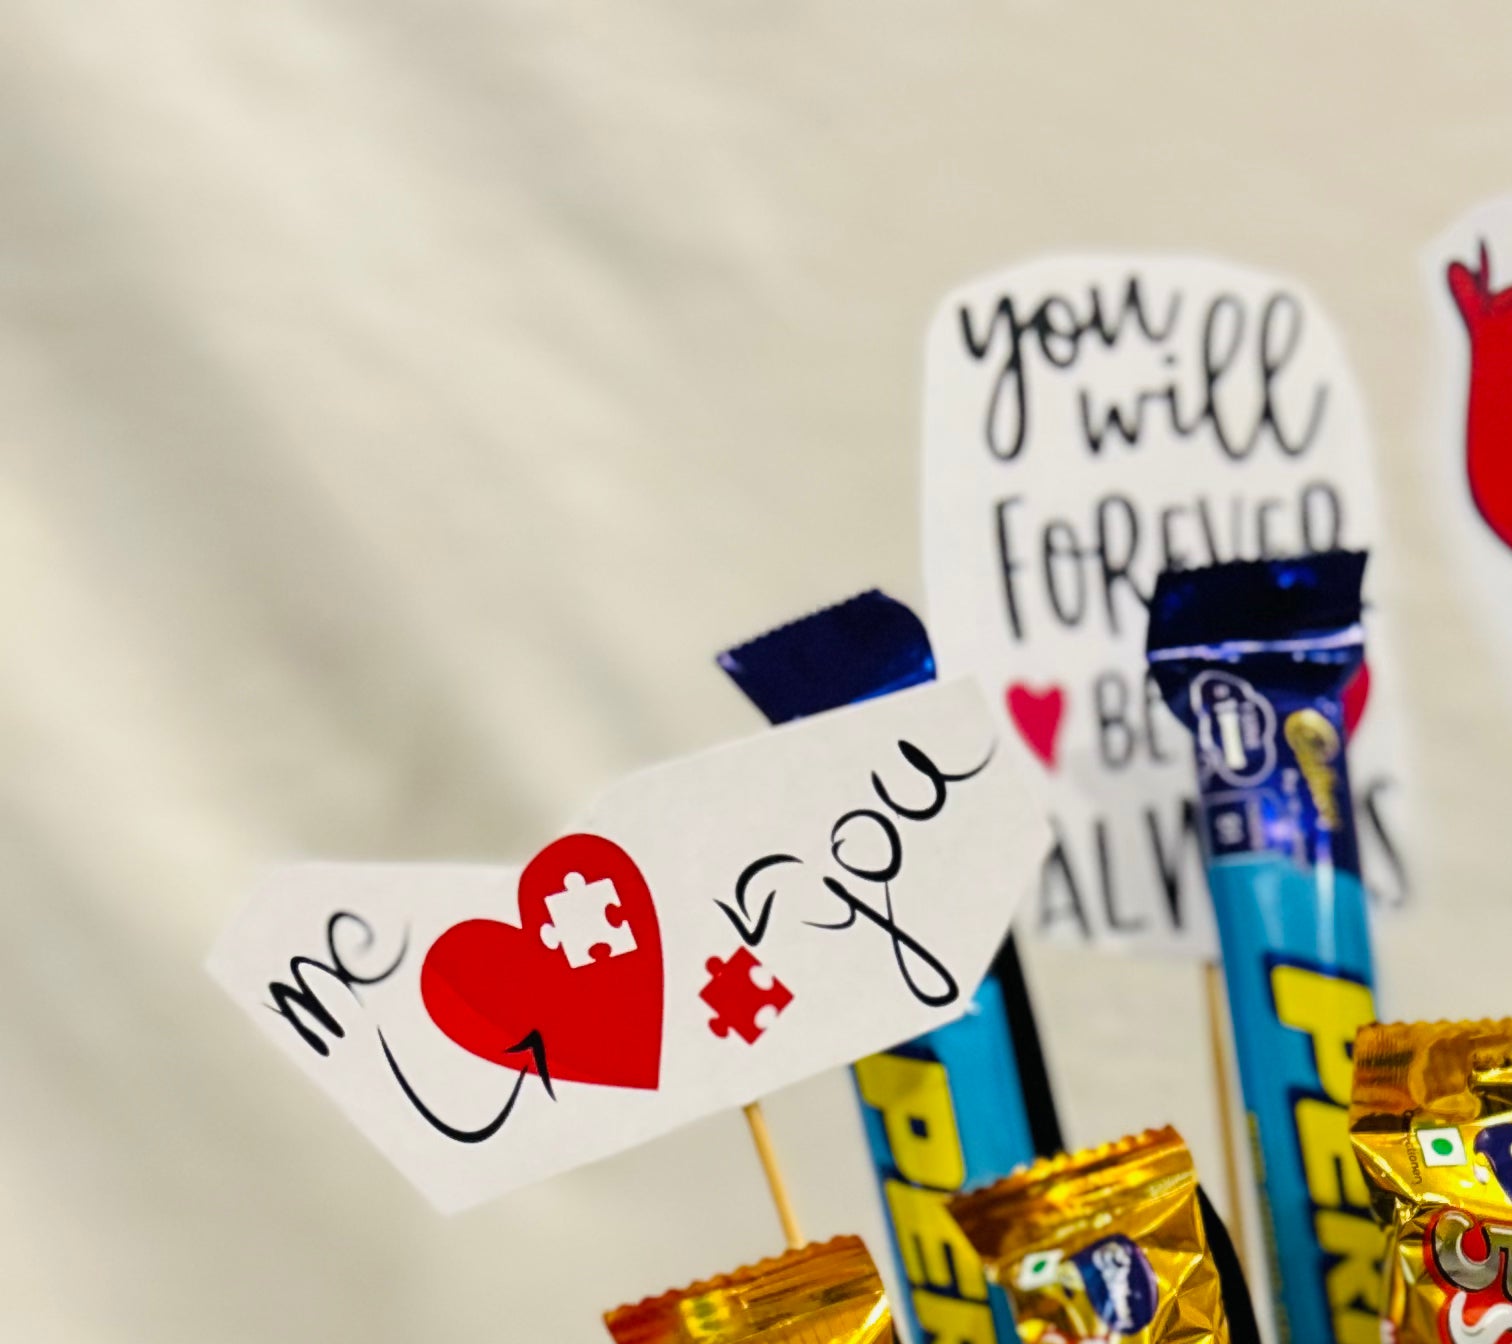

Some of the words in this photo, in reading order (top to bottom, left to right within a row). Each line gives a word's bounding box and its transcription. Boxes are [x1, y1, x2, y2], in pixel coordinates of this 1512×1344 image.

[958, 274, 1183, 462] you
[1080, 292, 1330, 462] will
[801, 738, 998, 1007] you
[264, 910, 410, 1058] me
